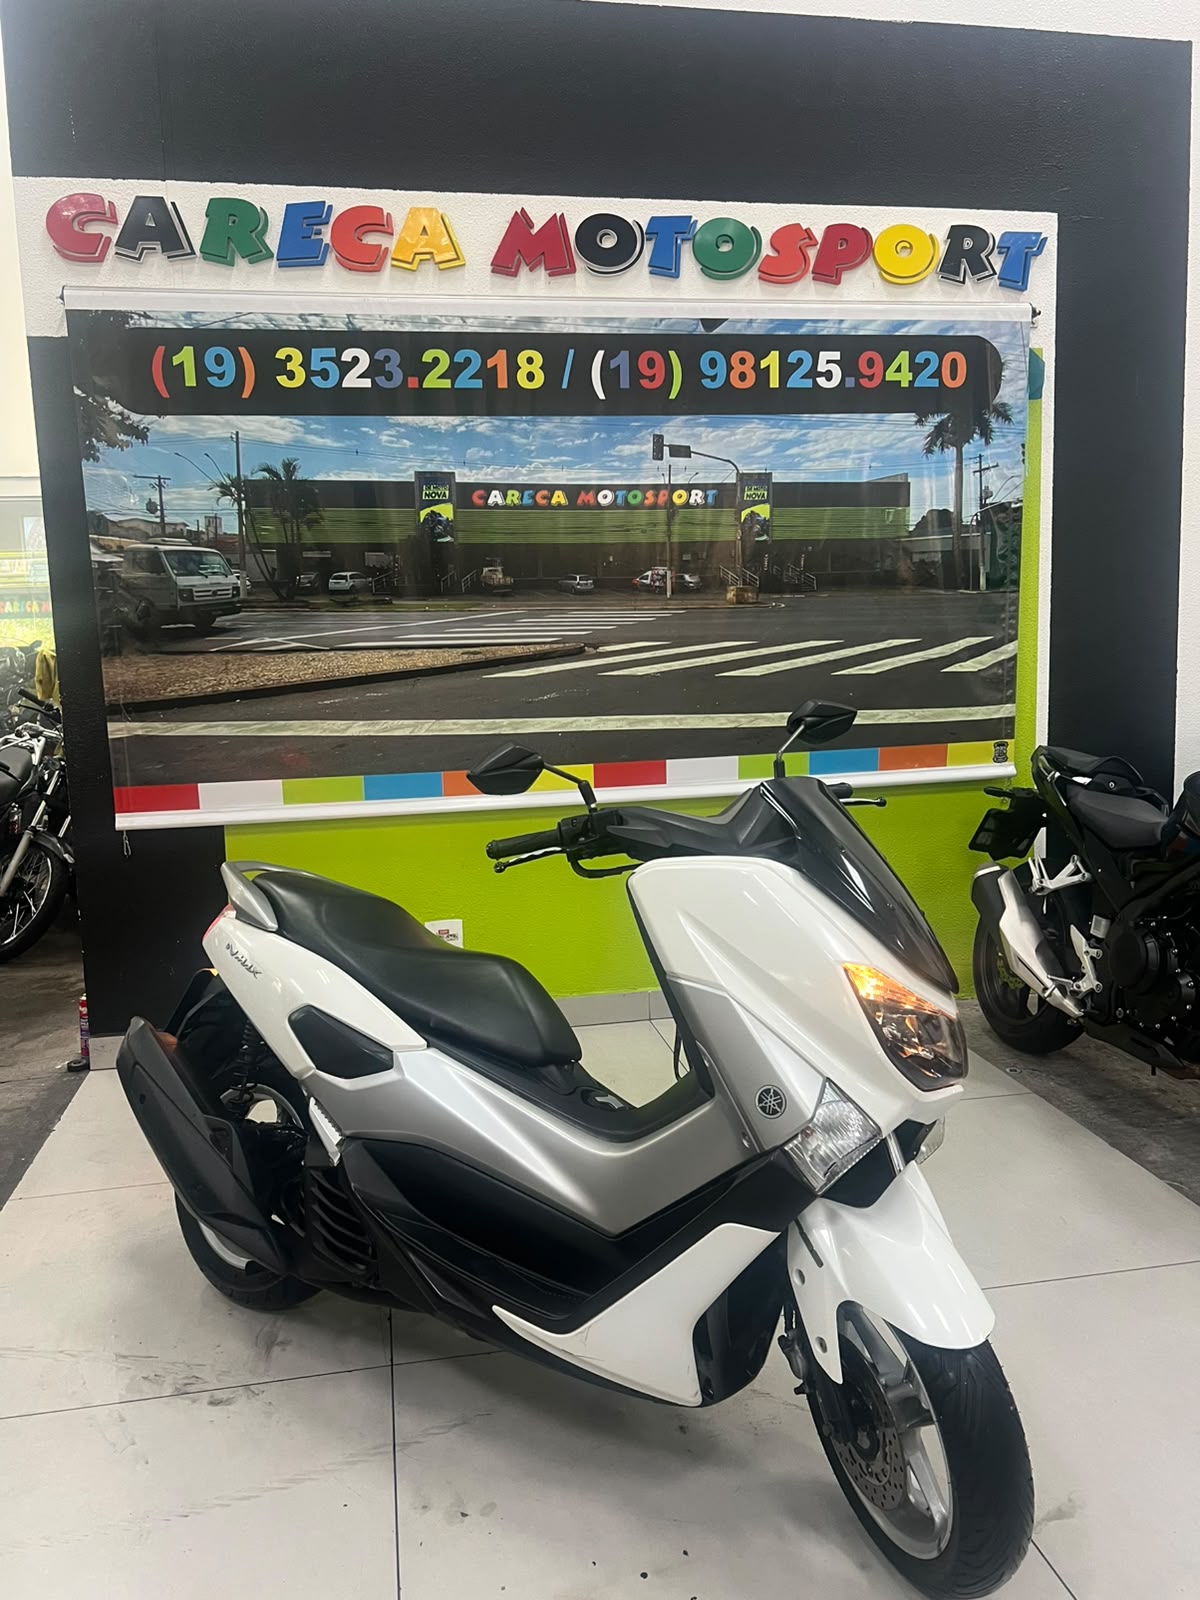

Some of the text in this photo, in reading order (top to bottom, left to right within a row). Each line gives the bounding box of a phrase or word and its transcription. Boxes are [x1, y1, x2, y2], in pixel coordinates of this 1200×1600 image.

[45, 192, 1048, 292] CARECA MOTOSPORT
[151, 345, 968, 400] (19) 3523.2218 / (19) 98125.9420
[424, 490, 448, 499] NOVA
[471, 488, 719, 507] CARECA MOTOSPORT
